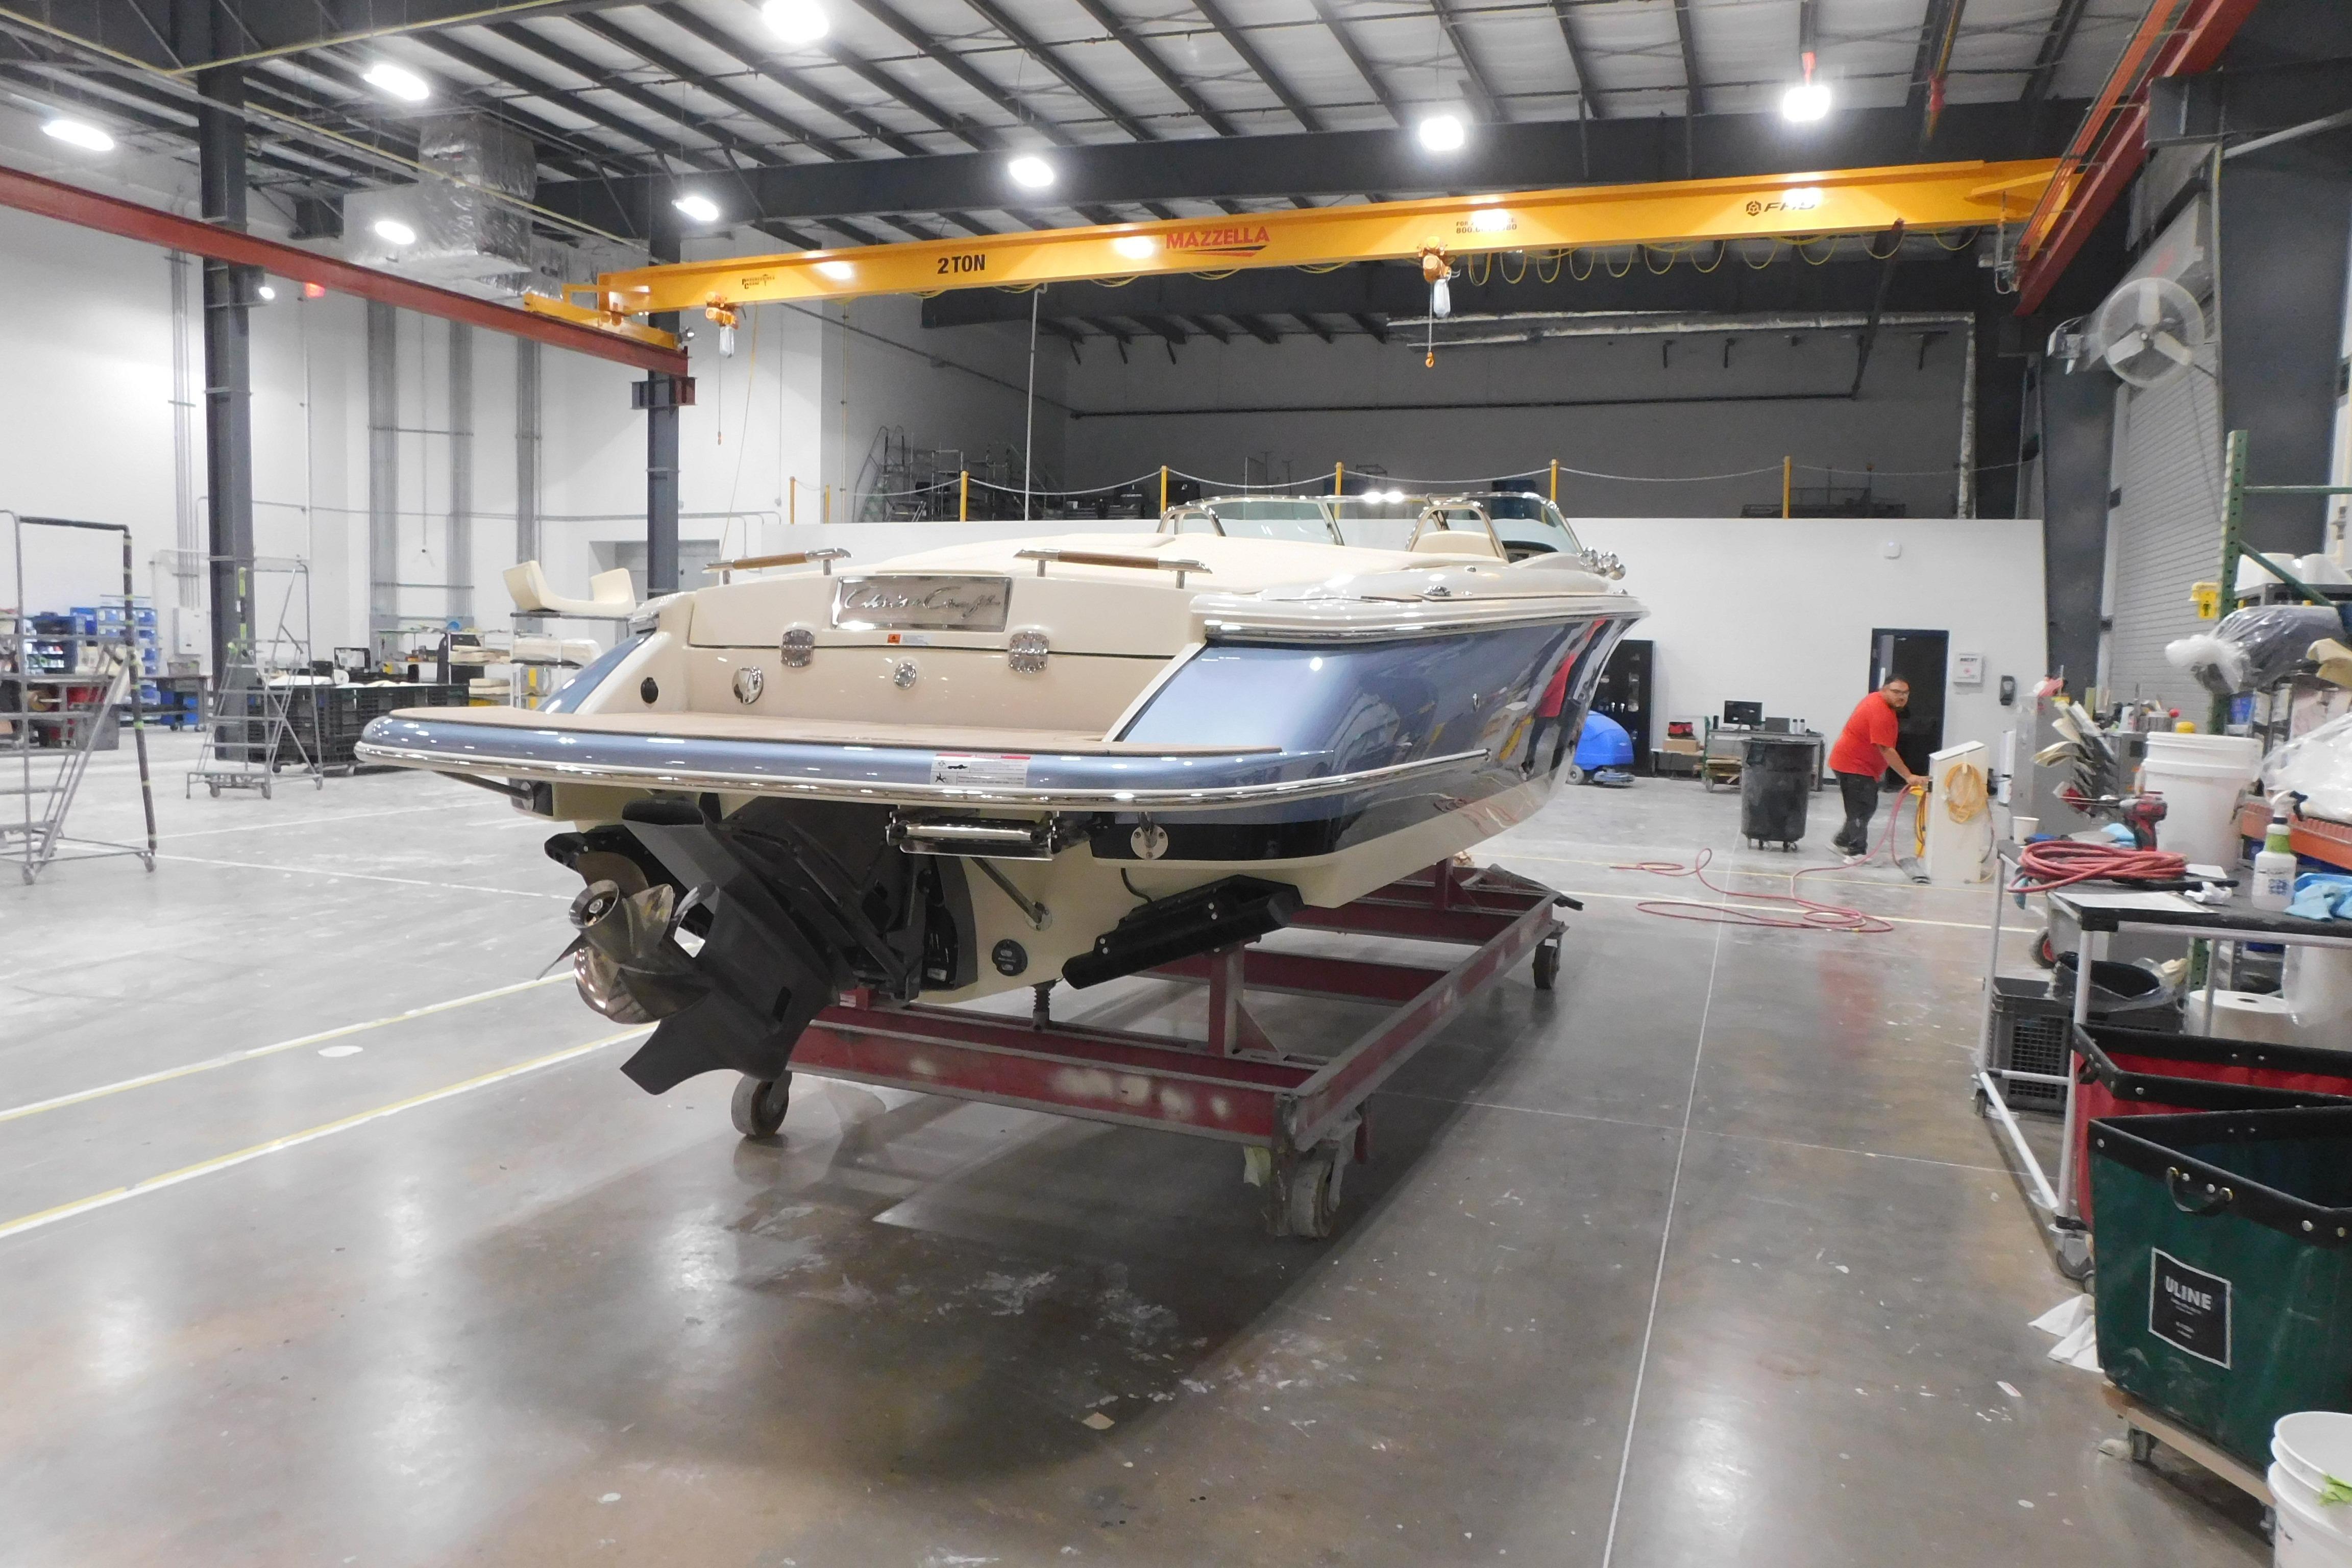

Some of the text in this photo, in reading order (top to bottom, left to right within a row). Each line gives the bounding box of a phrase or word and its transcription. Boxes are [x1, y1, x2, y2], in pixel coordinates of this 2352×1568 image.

[1166, 226, 1270, 249] MAZZELLA
[937, 254, 986, 275] 2 TON
[2165, 1275, 2213, 1311] ULINE
